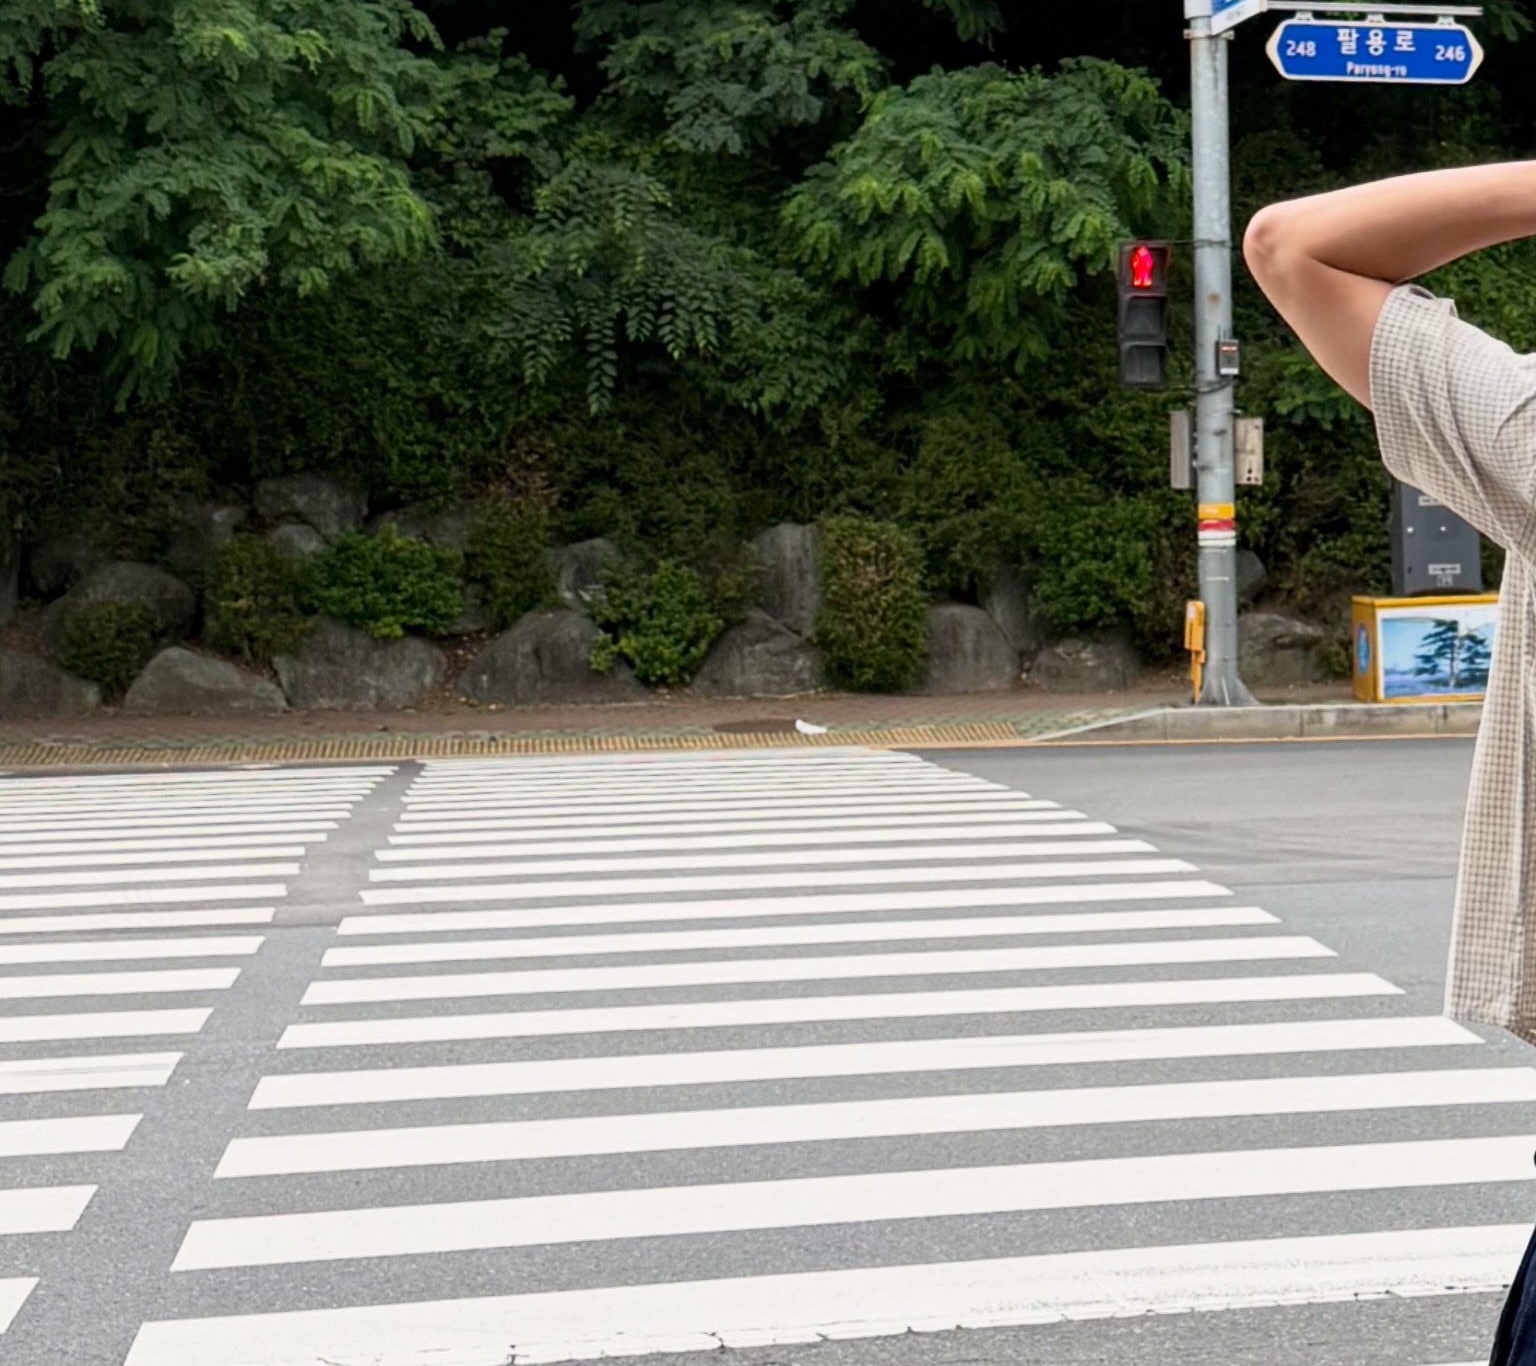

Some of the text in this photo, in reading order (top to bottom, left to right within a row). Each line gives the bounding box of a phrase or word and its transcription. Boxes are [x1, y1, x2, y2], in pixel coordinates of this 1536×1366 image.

[1286, 28, 1466, 62] 248 팔용로 246
